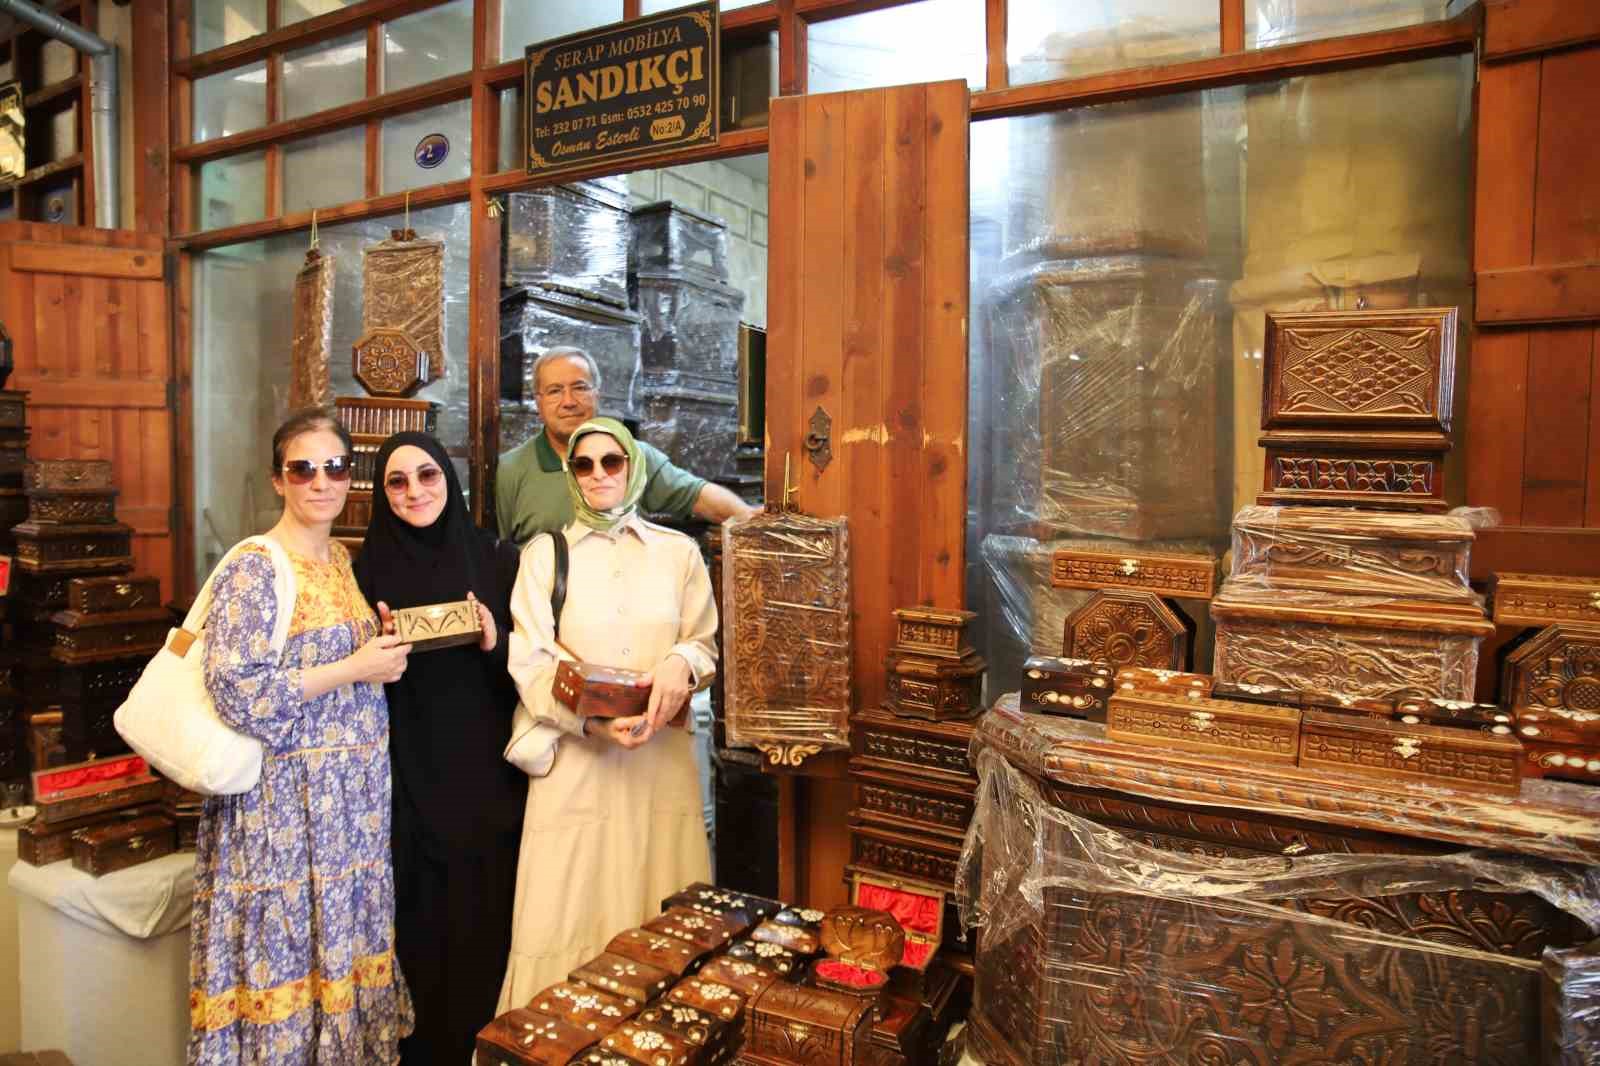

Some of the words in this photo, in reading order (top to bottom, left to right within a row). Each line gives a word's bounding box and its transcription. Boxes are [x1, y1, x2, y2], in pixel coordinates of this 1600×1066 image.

[554, 45, 604, 71] SERAP
[608, 27, 681, 57] MOBİLYA
[537, 46, 703, 113] SANDIKÇI
[536, 127, 550, 138] Tel:
[553, 121, 569, 135] 232
[572, 118, 584, 130] 07
[584, 114, 597, 127] 71
[601, 112, 624, 125] Gsm:
[627, 104, 652, 119] 0532
[655, 100, 673, 114] 425
[676, 97, 689, 110] 70
[693, 95, 705, 107] 90
[552, 141, 592, 157] Osman
[596, 127, 640, 150] Esterli
